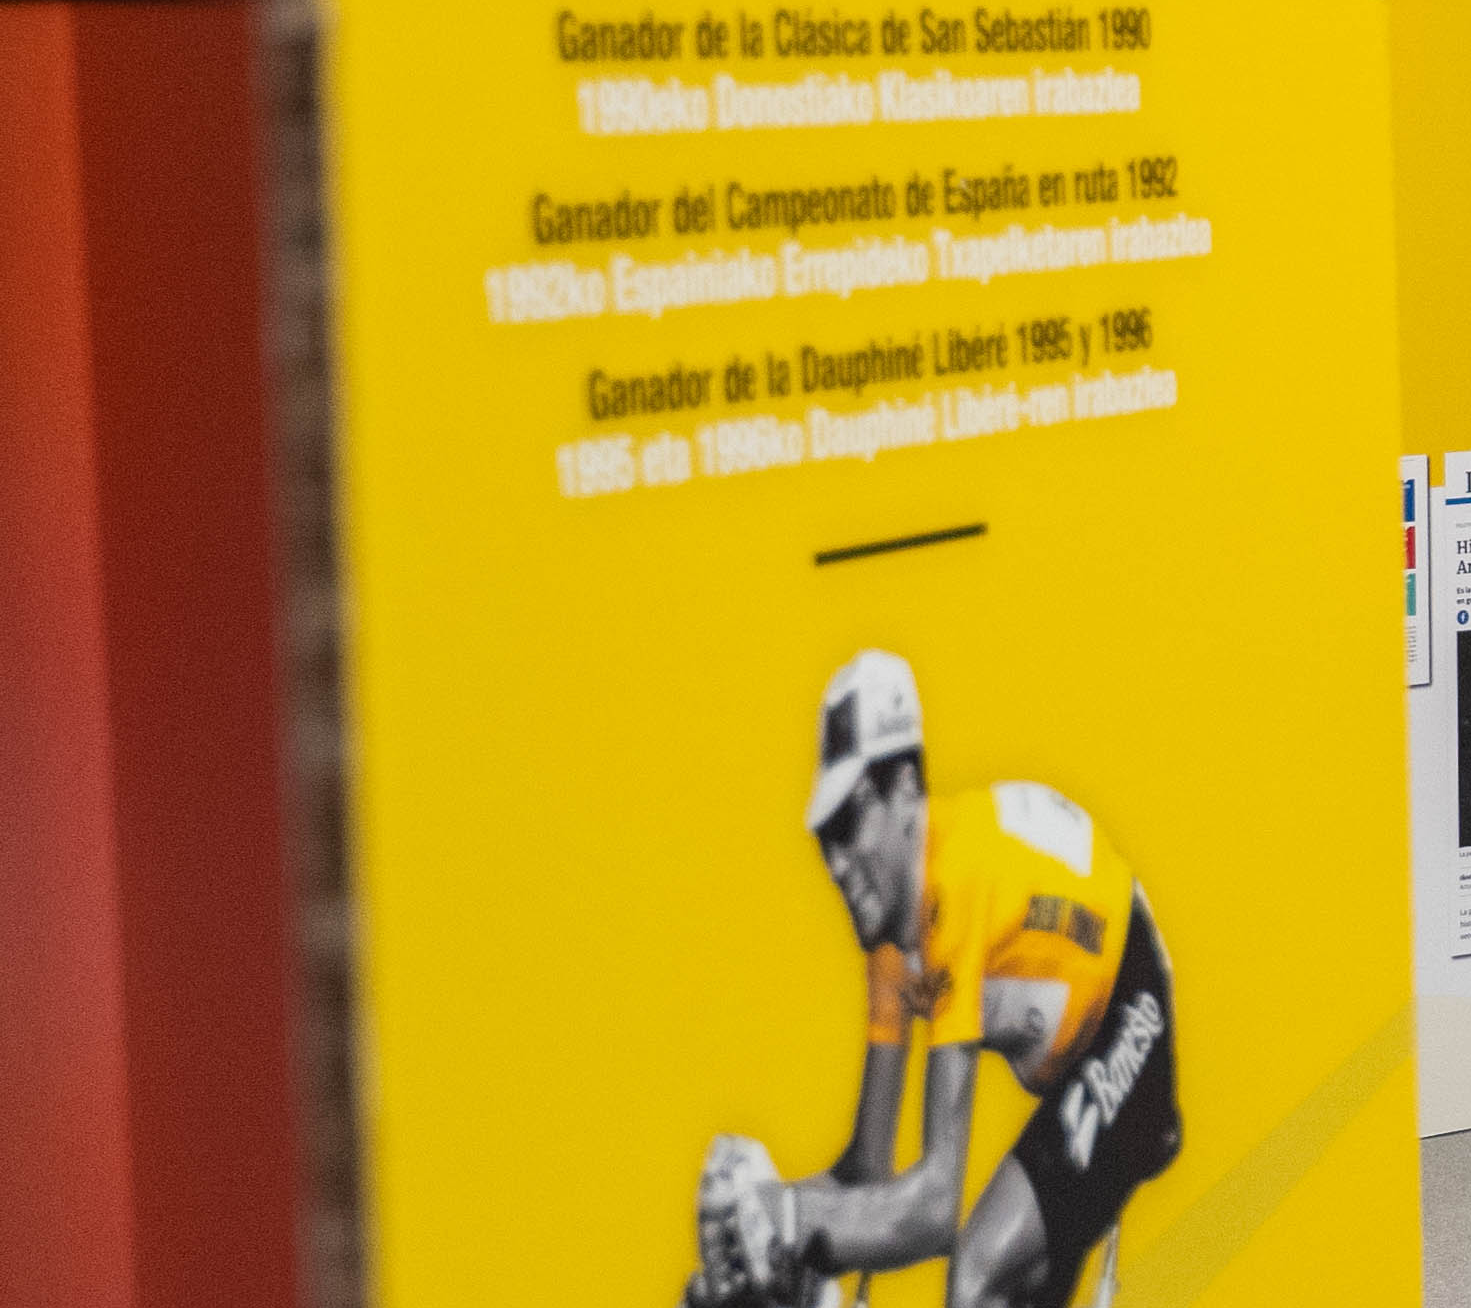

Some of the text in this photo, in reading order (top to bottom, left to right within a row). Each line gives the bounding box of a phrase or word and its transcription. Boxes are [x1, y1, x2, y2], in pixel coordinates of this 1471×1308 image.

[552, 7, 1154, 62] Ganador de la Clásica de San Sebastián 1990
[529, 155, 1181, 244] Ganador del Campeonato de España en ruta 1992
